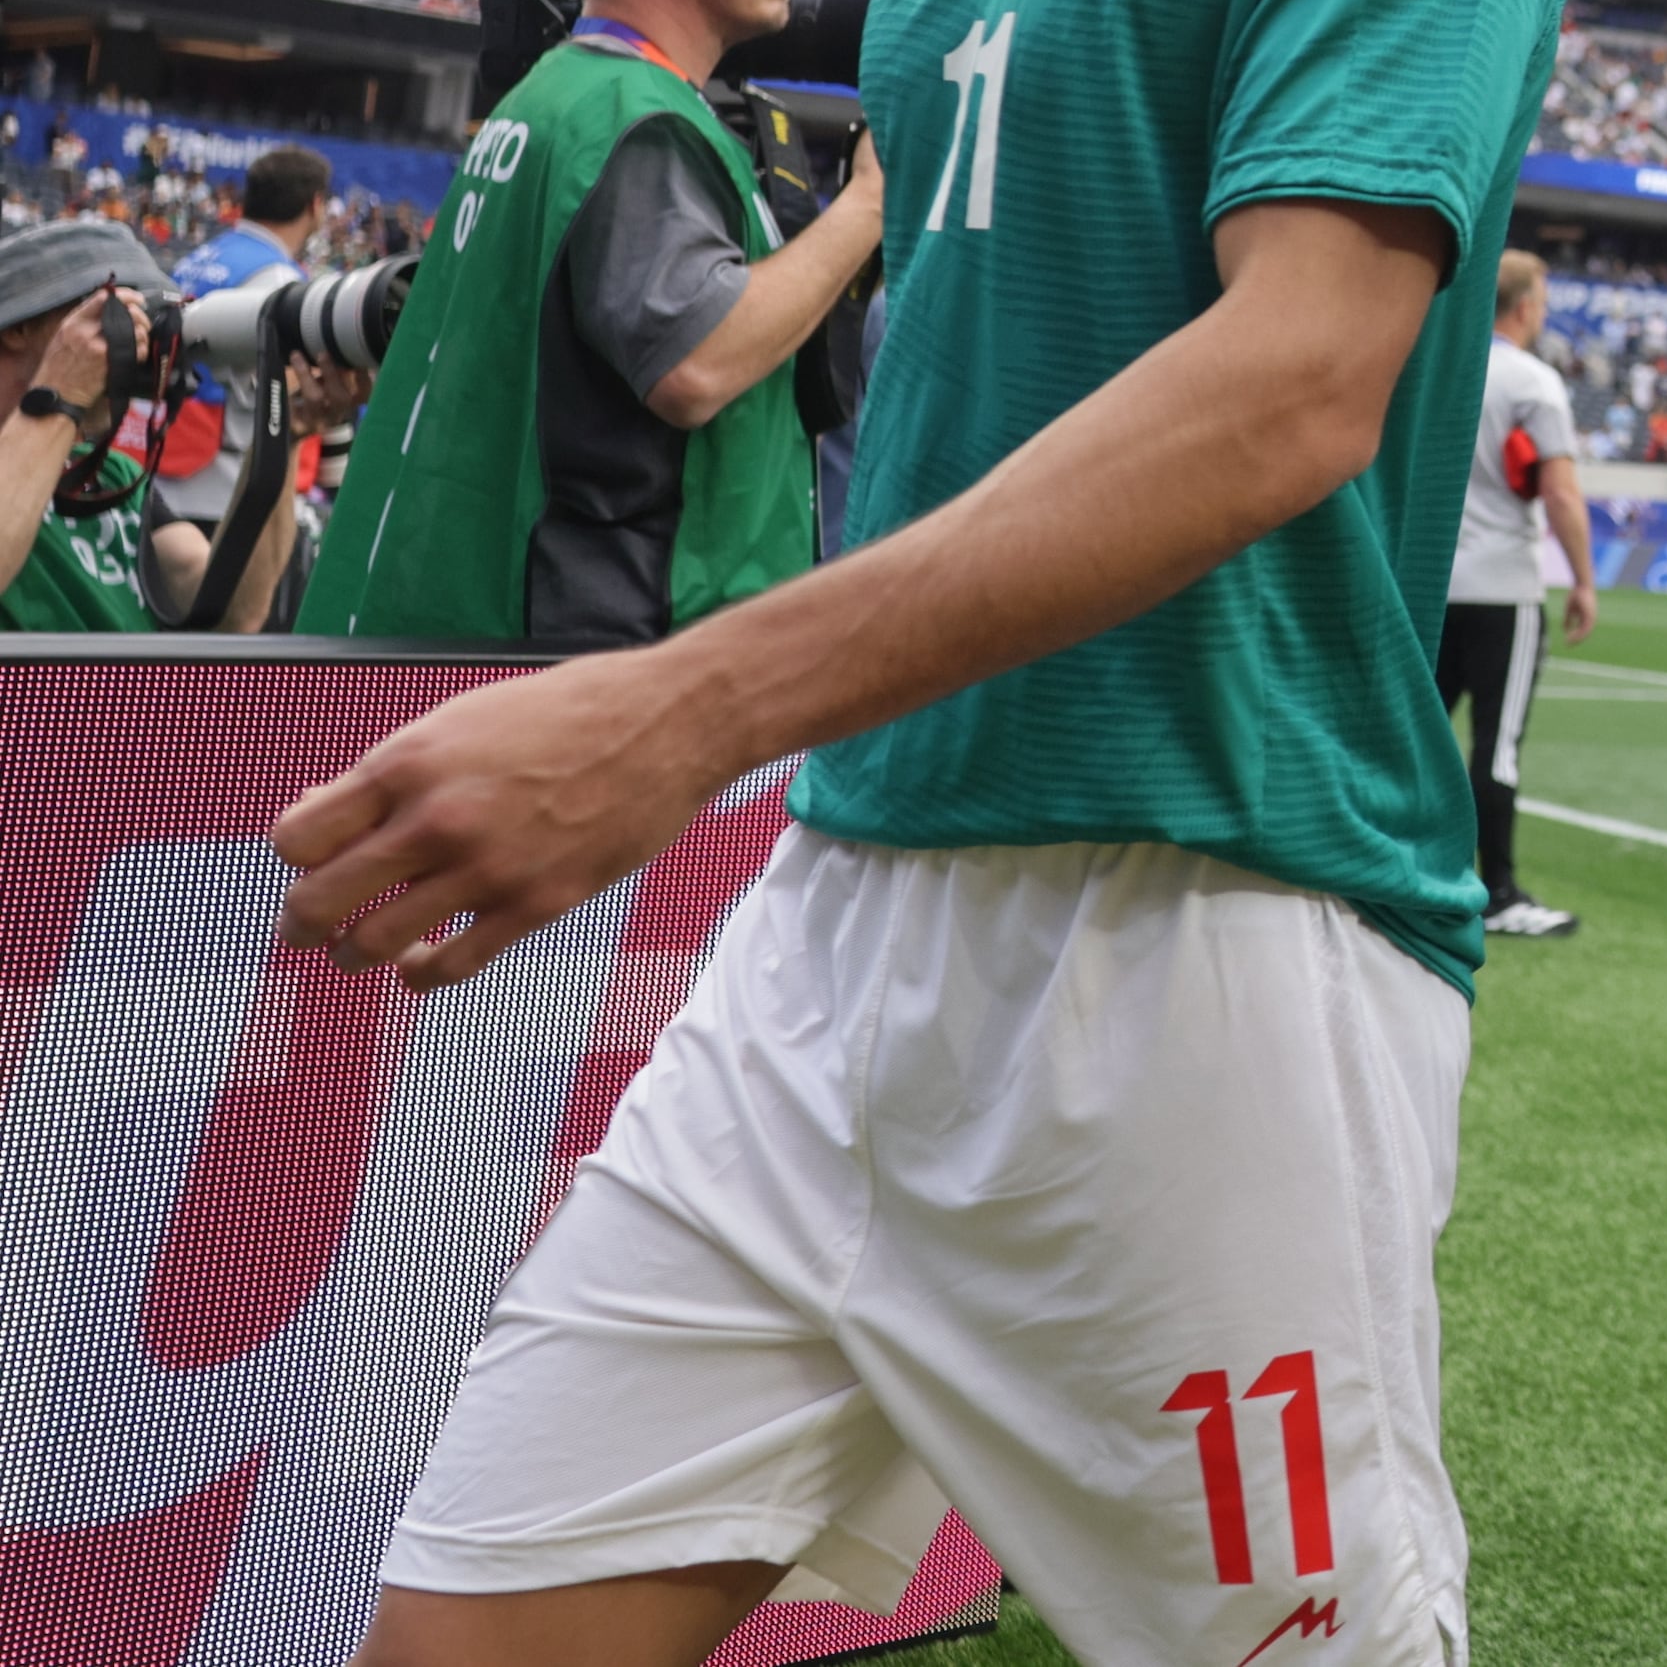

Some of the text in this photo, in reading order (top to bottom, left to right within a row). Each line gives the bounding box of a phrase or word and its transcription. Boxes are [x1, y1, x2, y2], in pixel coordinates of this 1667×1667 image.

[926, 12, 1016, 231] 11
[268, 379, 281, 437] Canon
[1158, 1349, 1335, 1585] 11
